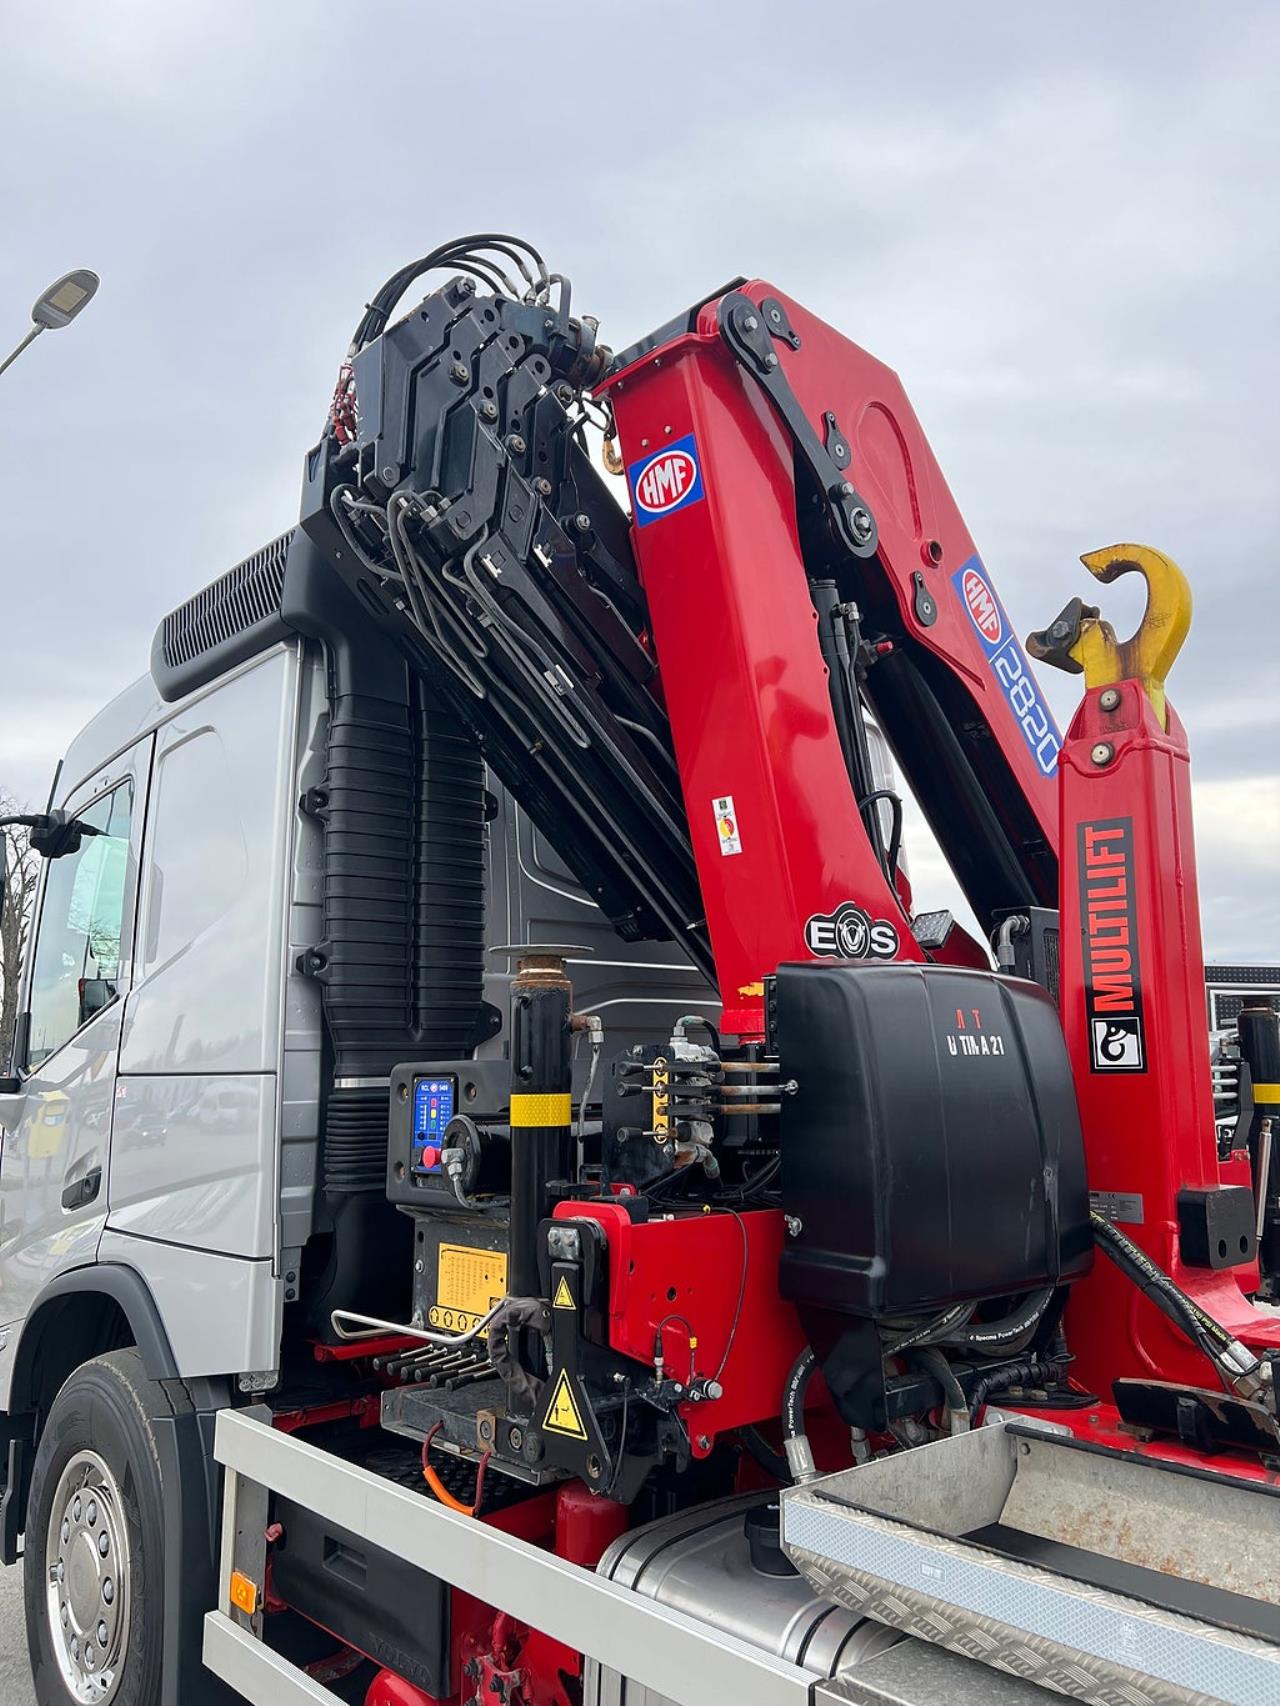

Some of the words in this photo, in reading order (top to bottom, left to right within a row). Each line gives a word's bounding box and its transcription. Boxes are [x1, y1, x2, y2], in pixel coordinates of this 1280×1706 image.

[642, 458, 686, 505] HMF
[965, 576, 999, 633] HMF
[994, 646, 1060, 774] 2820
[1084, 826, 1135, 1012] MULTILIFT
